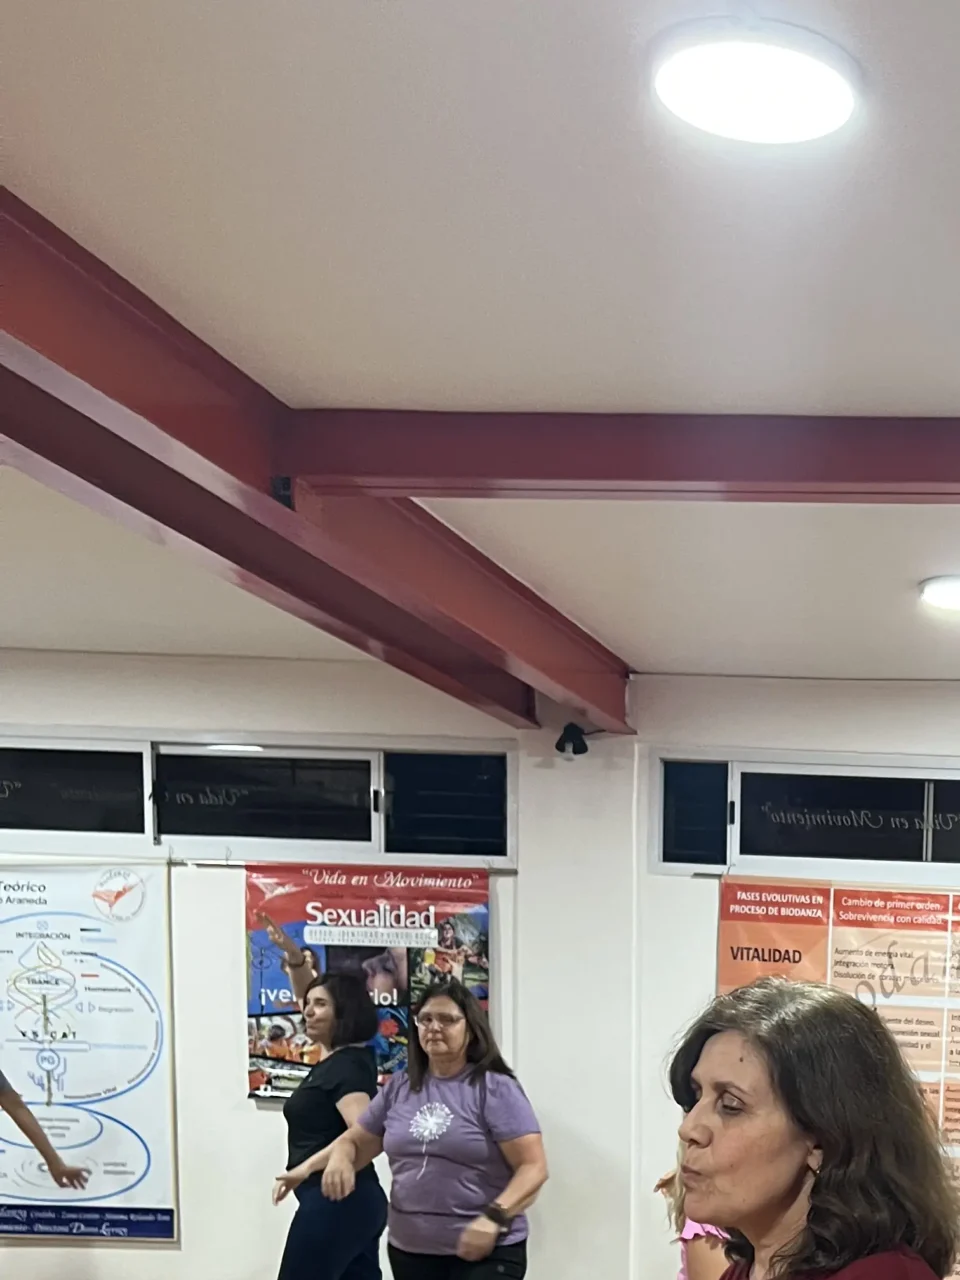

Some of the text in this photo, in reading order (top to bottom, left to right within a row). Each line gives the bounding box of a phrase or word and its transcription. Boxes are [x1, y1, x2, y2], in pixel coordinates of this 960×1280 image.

[350, 875, 369, 886] en
[737, 890, 823, 904] FASES EVOLUTIVAS EN
[841, 896, 872, 907] Cambio
[873, 897, 885, 908] de
[886, 898, 916, 912] primer
[305, 901, 436, 929] Sexualidad
[729, 904, 823, 918] PROCESO DE BIODANZA
[839, 911, 895, 924] Sobrevivencia
[896, 914, 911, 923] con
[16, 931, 71, 940] INTEGRACIÓN
[730, 946, 802, 964] VITALIDAD
[834, 947, 864, 957] Aumento
[864, 949, 873, 957] de
[833, 971, 866, 980] Disolución
[867, 971, 876, 980] de
[369, 987, 399, 1006] lo!
